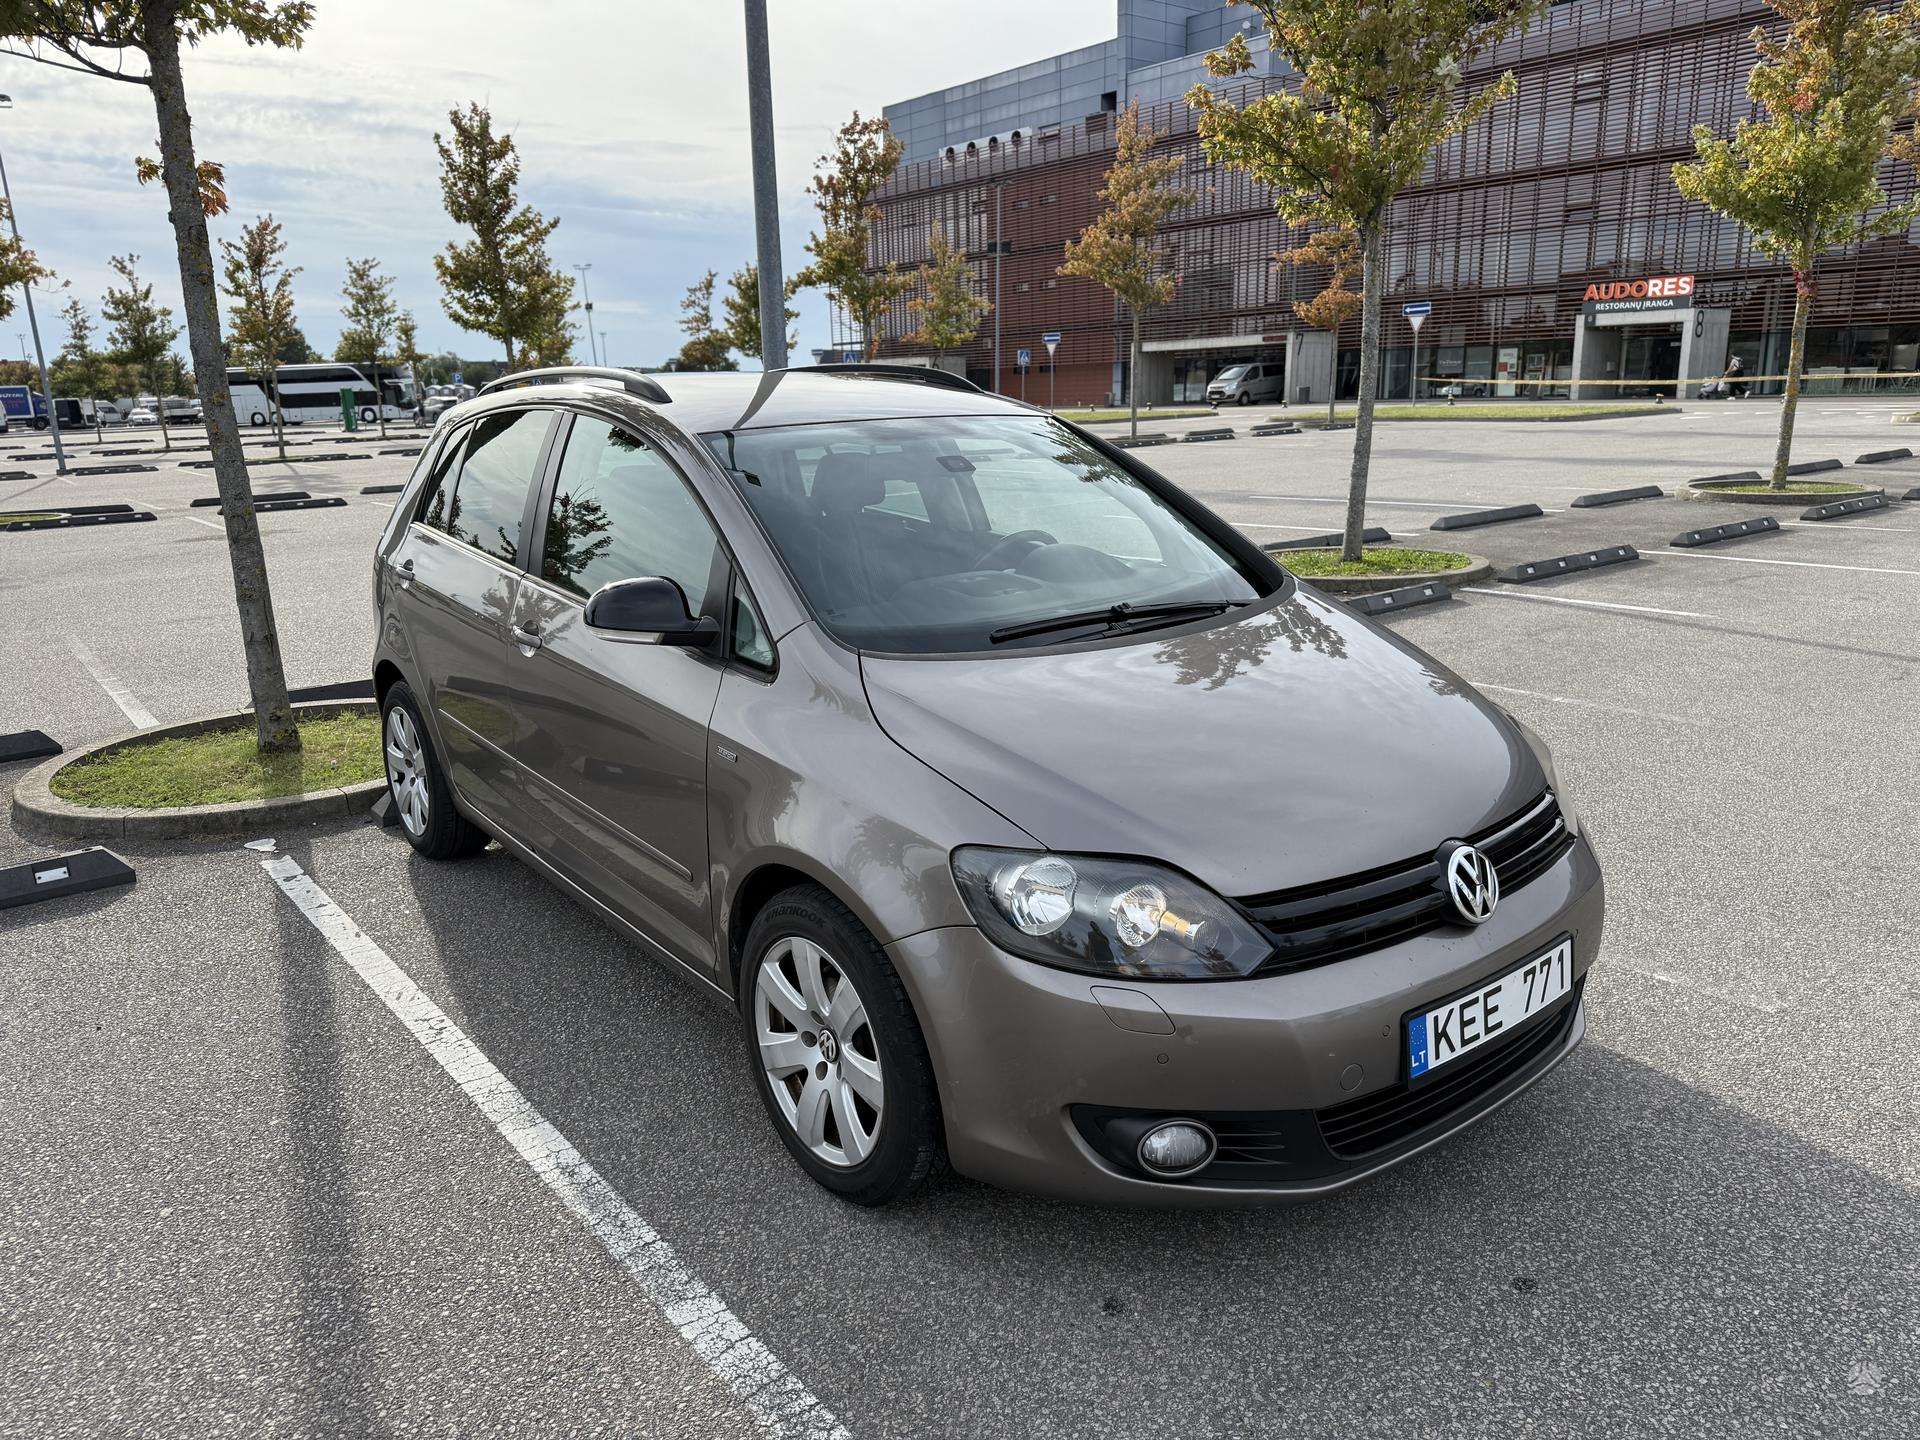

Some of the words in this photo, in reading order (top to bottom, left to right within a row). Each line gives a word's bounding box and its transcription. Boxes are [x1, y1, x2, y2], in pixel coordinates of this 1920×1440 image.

[1583, 275, 1693, 300] AUDORES
[1595, 302, 1642, 311] RESTORANŲ
[1643, 299, 1674, 310] ĮRANGA
[1695, 310, 1705, 338] 8
[1296, 333, 1304, 356] 7
[1433, 984, 1503, 1061] KEE
[1523, 948, 1565, 1014] 771
[1411, 1050, 1426, 1067] LT
